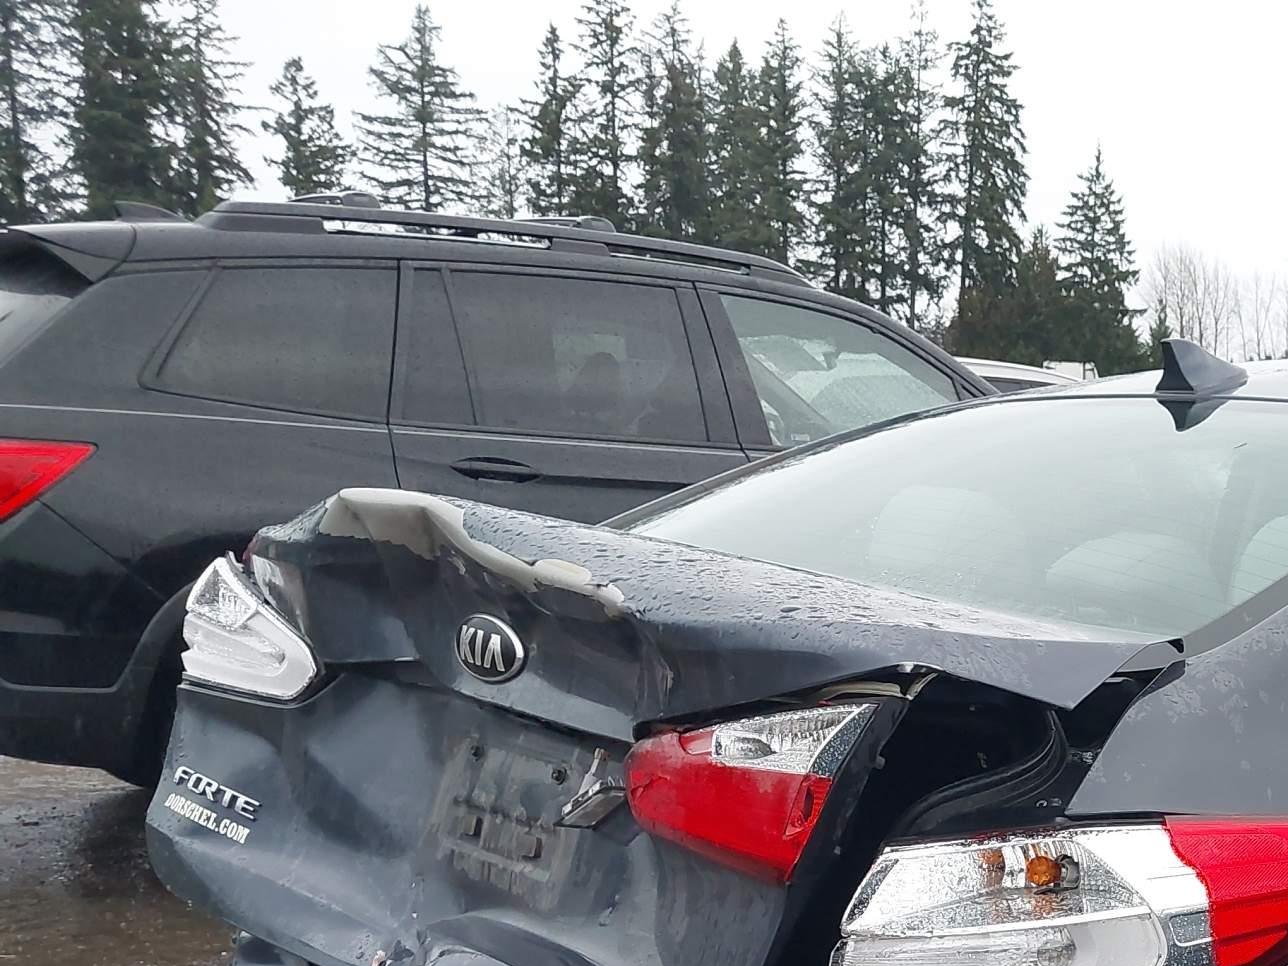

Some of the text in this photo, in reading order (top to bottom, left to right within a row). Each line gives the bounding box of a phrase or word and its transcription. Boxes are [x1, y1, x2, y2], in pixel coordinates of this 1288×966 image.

[460, 624, 506, 672] KIA
[163, 793, 251, 845] DORSCHEL.COM
[173, 766, 262, 820] FORTE
